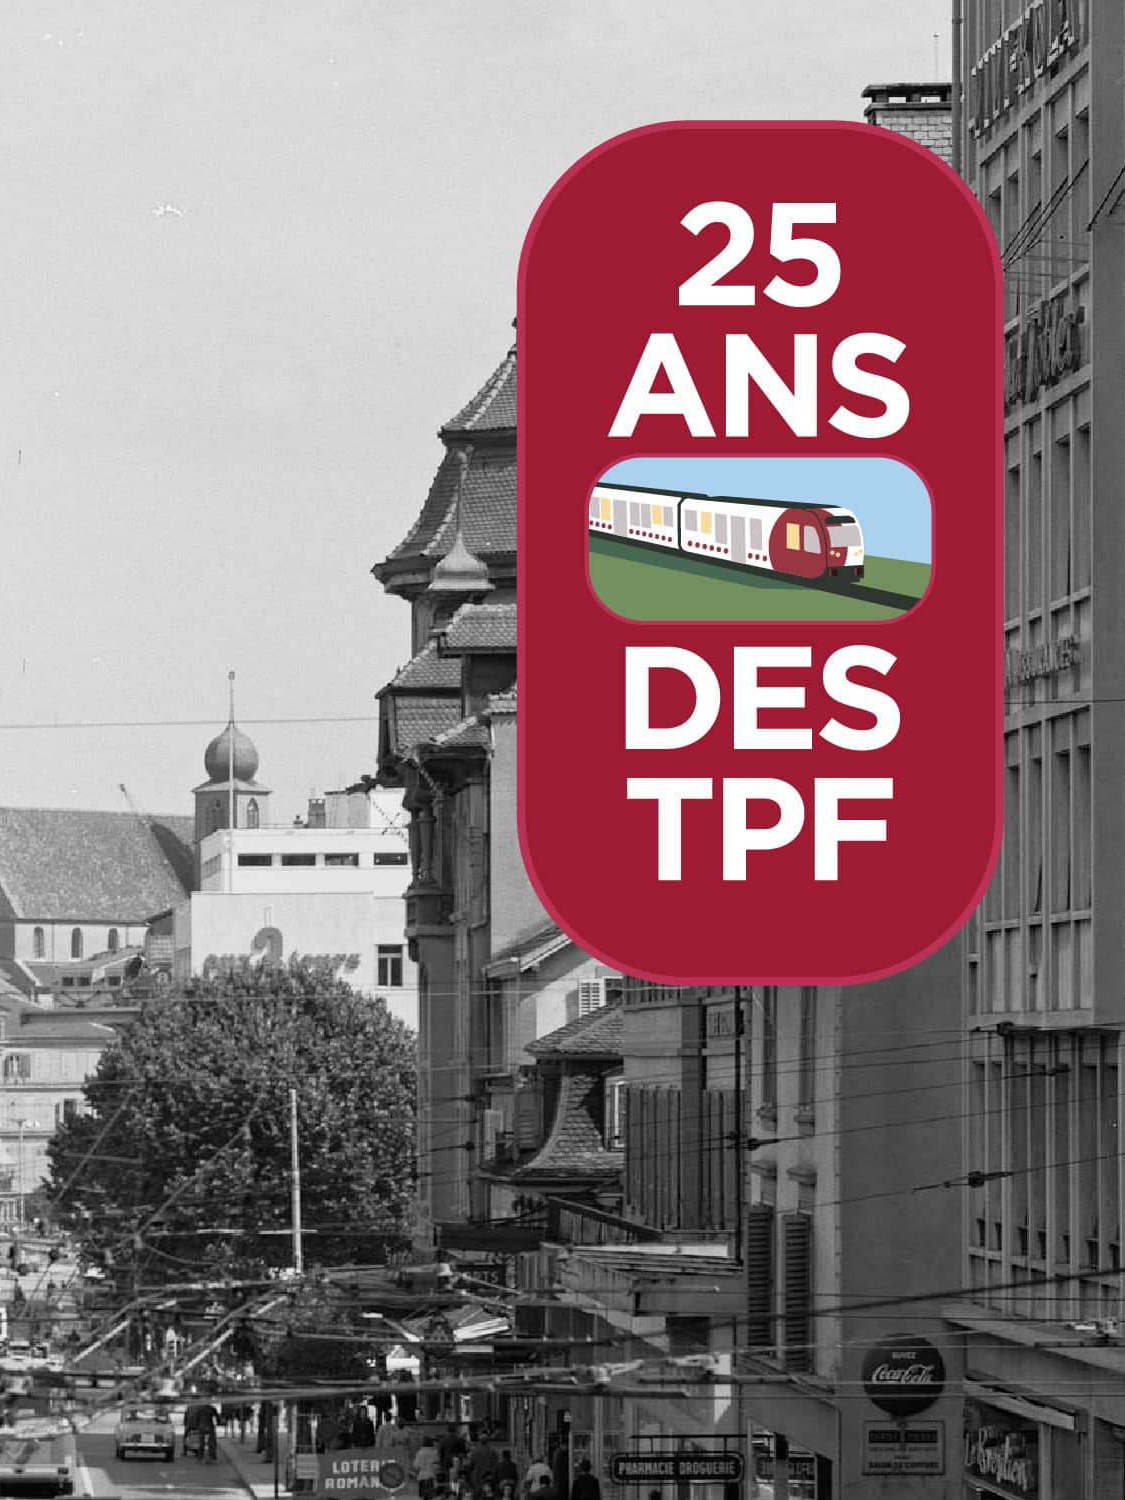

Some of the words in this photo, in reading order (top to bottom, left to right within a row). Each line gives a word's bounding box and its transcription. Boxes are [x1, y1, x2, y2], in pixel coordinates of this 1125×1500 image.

[332, 1459, 397, 1475] LOTER
[619, 1461, 675, 1475] PHARMACIE
[680, 1461, 736, 1475] DROGUERIE
[325, 1475, 393, 1489] ROMAN
